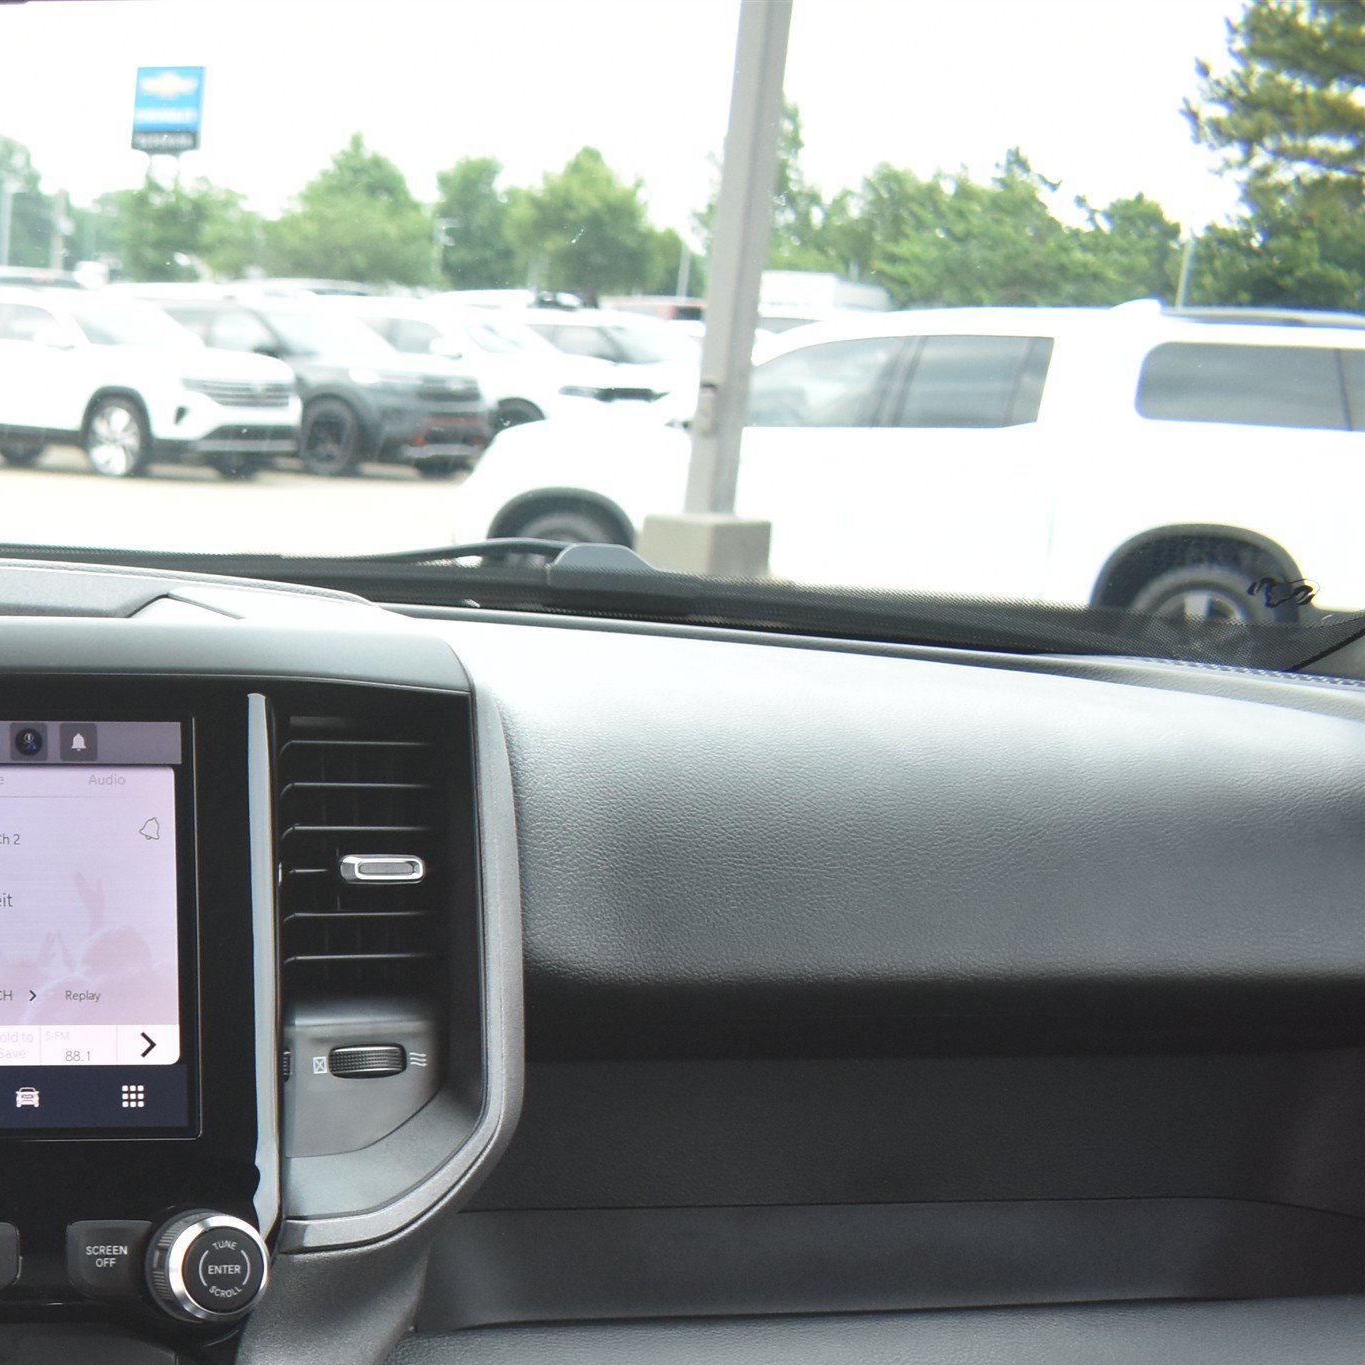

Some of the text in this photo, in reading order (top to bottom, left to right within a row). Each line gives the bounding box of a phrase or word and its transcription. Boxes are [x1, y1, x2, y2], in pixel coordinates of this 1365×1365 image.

[88, 773, 126, 786] Audio
[13, 834, 20, 845] 2
[65, 990, 101, 1003] Replay
[22, 1032, 34, 1043] to
[65, 1050, 91, 1062] 88.1
[85, 1245, 128, 1256] SCREEN
[212, 1240, 238, 1251] TUNE
[95, 1258, 116, 1268] OFF
[208, 1265, 241, 1275] ENTER
[208, 1285, 242, 1298] SCROLL
